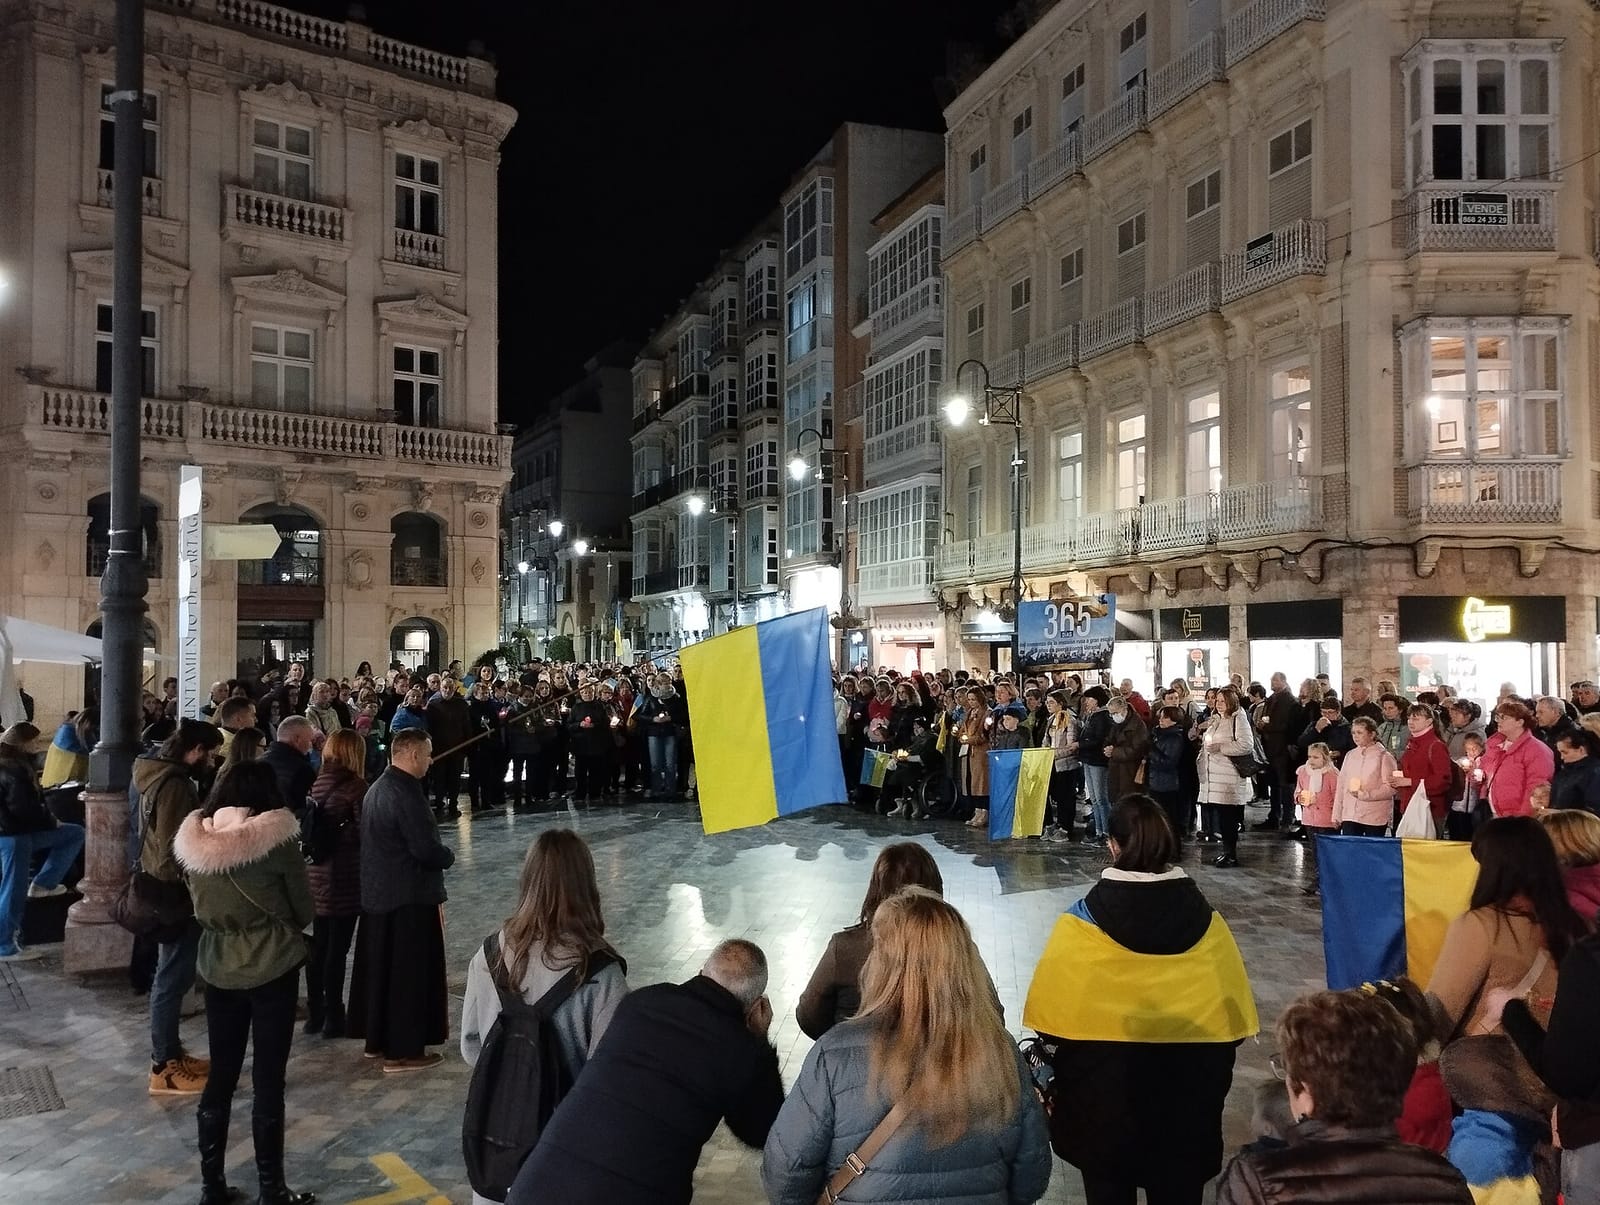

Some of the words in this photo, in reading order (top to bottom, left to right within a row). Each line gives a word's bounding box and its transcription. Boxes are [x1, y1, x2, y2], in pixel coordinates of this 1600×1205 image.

[1466, 204, 1503, 214] VENDE
[1487, 216, 1497, 224] 35
[1044, 602, 1091, 639] 365
